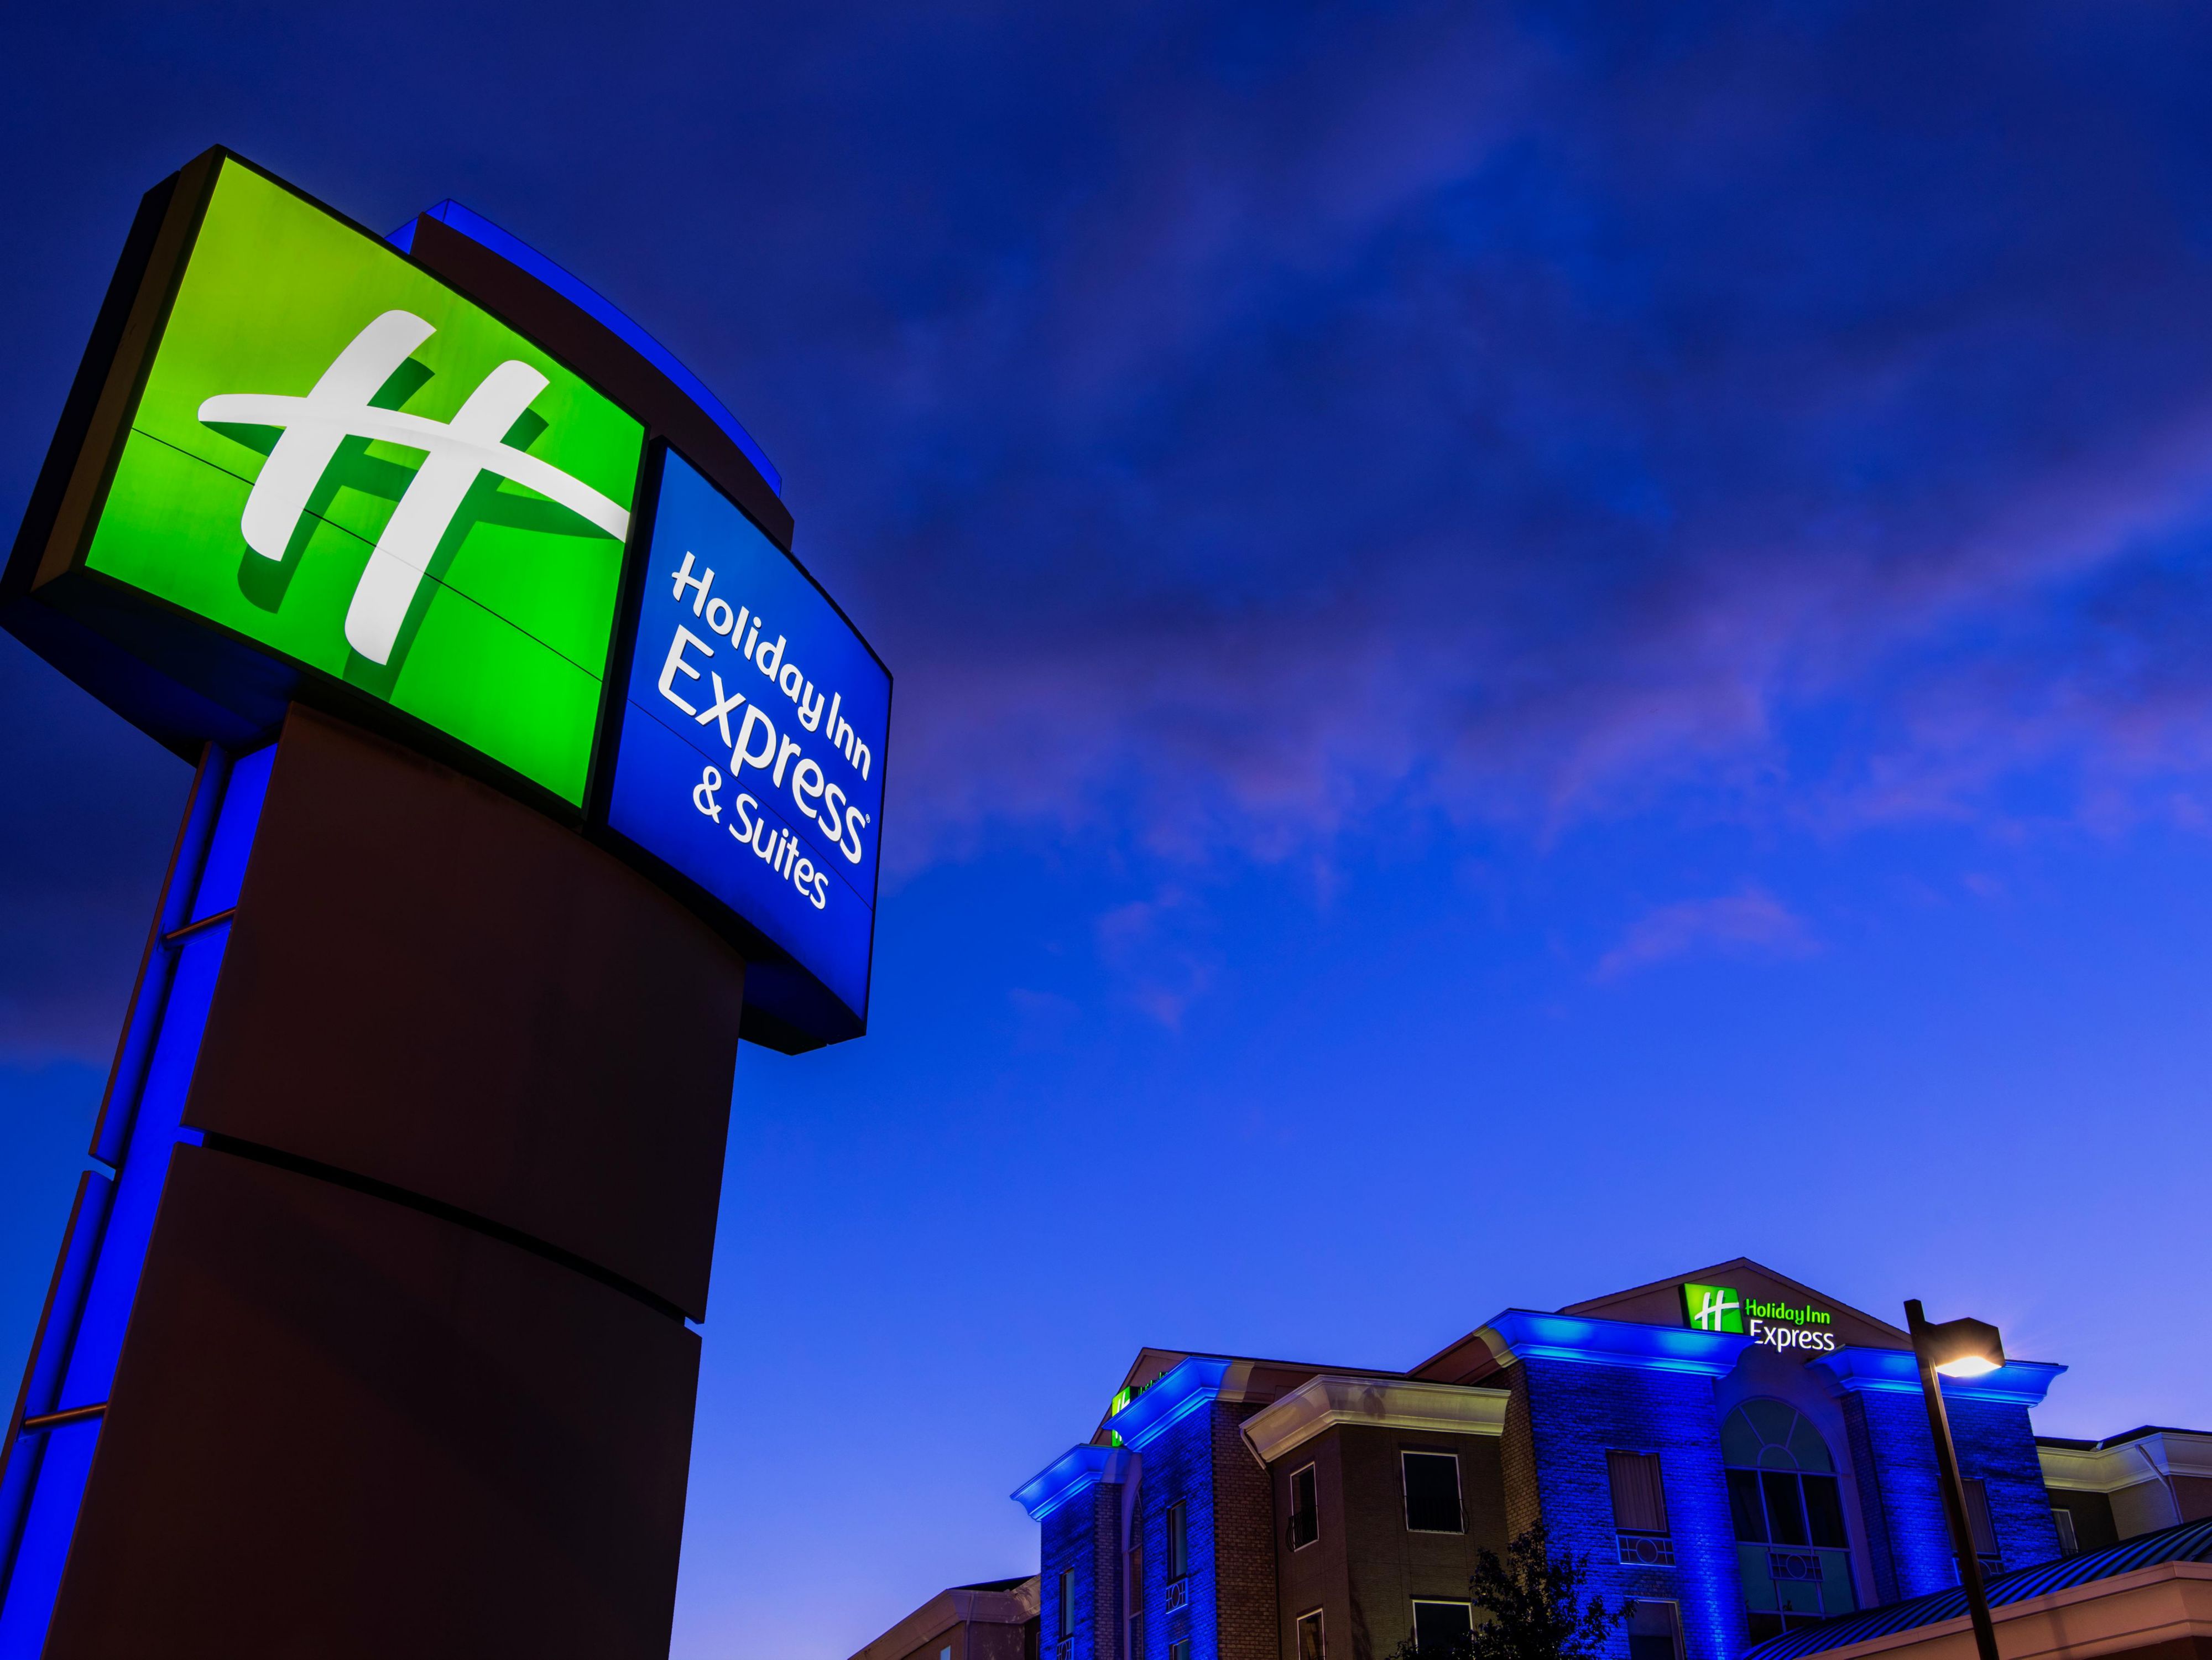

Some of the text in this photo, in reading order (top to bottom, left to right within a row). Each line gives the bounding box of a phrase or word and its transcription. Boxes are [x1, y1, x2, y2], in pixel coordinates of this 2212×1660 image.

[198, 309, 630, 665] H
[658, 624, 867, 865] Express
[671, 551, 871, 781] Holiday Inn
[693, 766, 829, 910] & Suites
[1745, 1298, 1830, 1325] Holiday Inn
[1750, 1319, 1835, 1352] Express
